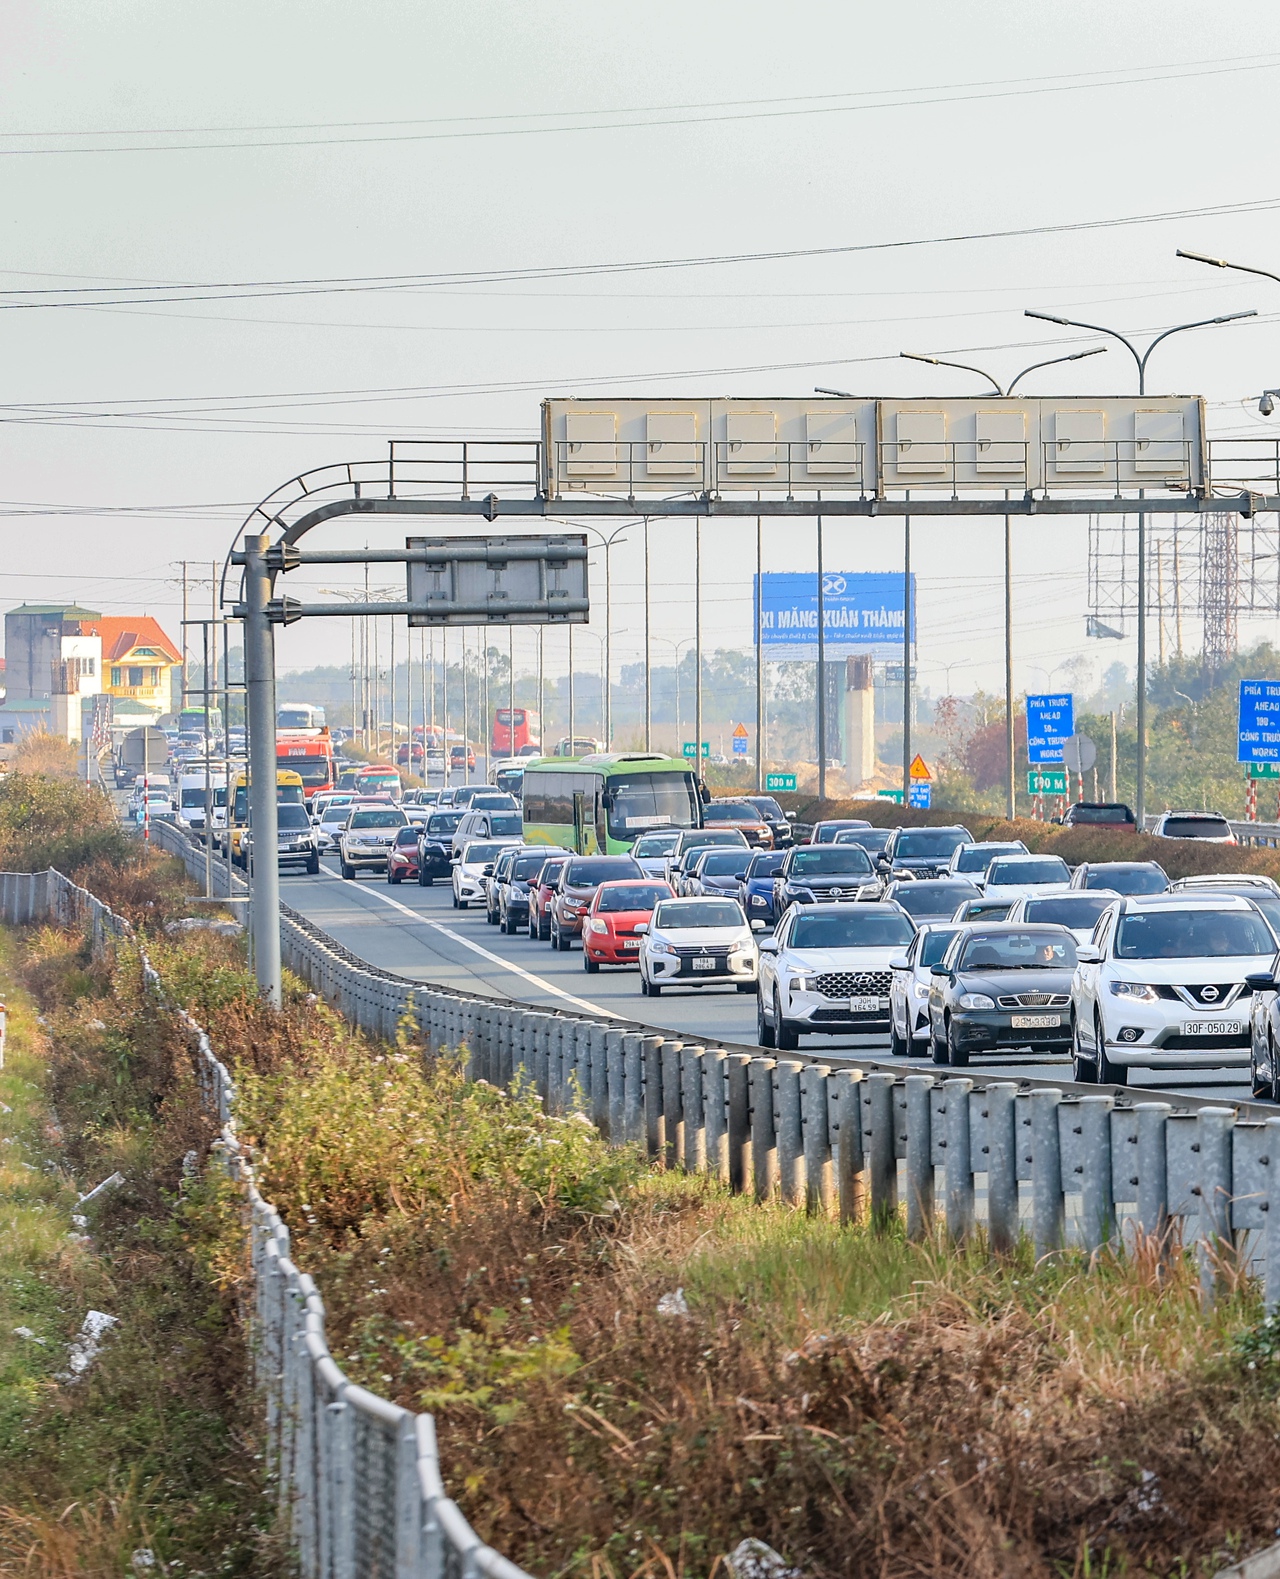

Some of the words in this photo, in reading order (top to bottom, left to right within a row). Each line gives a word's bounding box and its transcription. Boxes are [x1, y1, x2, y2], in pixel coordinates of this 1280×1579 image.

[761, 611, 774, 629] XI
[778, 606, 818, 629] MĂNG
[823, 606, 859, 628] XUÂN
[862, 606, 905, 628] THÀNH
[1244, 683, 1261, 696] PHÍA
[1254, 701, 1280, 711] AHEAD
[1040, 711, 1061, 720] AHEAD
[1240, 729, 1259, 742] CÔNG
[288, 747, 307, 756] FAW
[1040, 749, 1063, 759] WORKS
[1252, 747, 1279, 757] WORKS
[768, 777, 784, 787] 300
[785, 778, 794, 787] M
[1054, 778, 1064, 789] M
[1187, 1023, 1239, 1034] 30F-050.29
